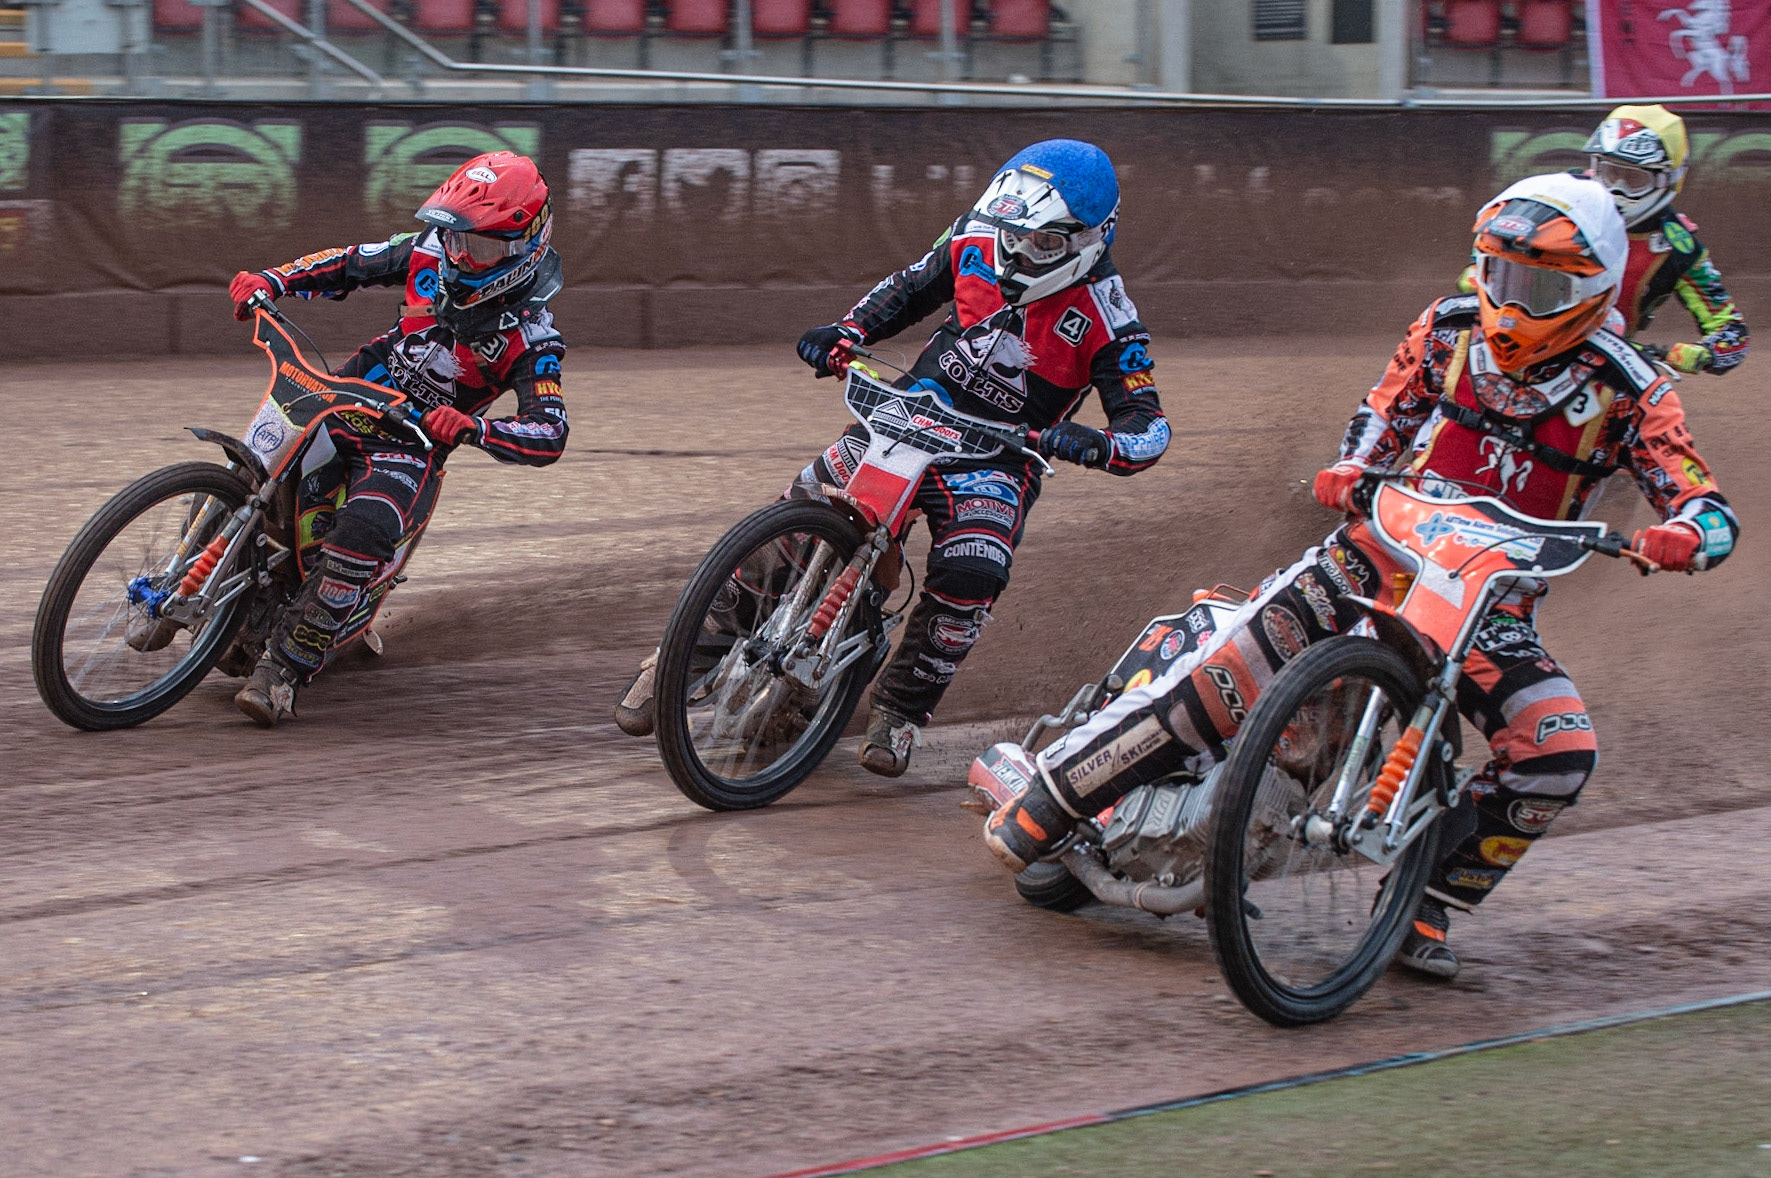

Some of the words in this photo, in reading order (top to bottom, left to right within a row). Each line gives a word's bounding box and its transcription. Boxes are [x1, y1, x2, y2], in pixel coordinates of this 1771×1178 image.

[279, 361, 338, 404] MOTORVATION
[939, 350, 1025, 414] COLTS
[1572, 392, 1589, 414] 3
[912, 415, 933, 428] CHM
[956, 498, 1015, 519] MOTIVE
[943, 541, 1007, 567] CONTENDER
[1069, 750, 1113, 785] SILVER
[1121, 743, 1144, 765] SKI
